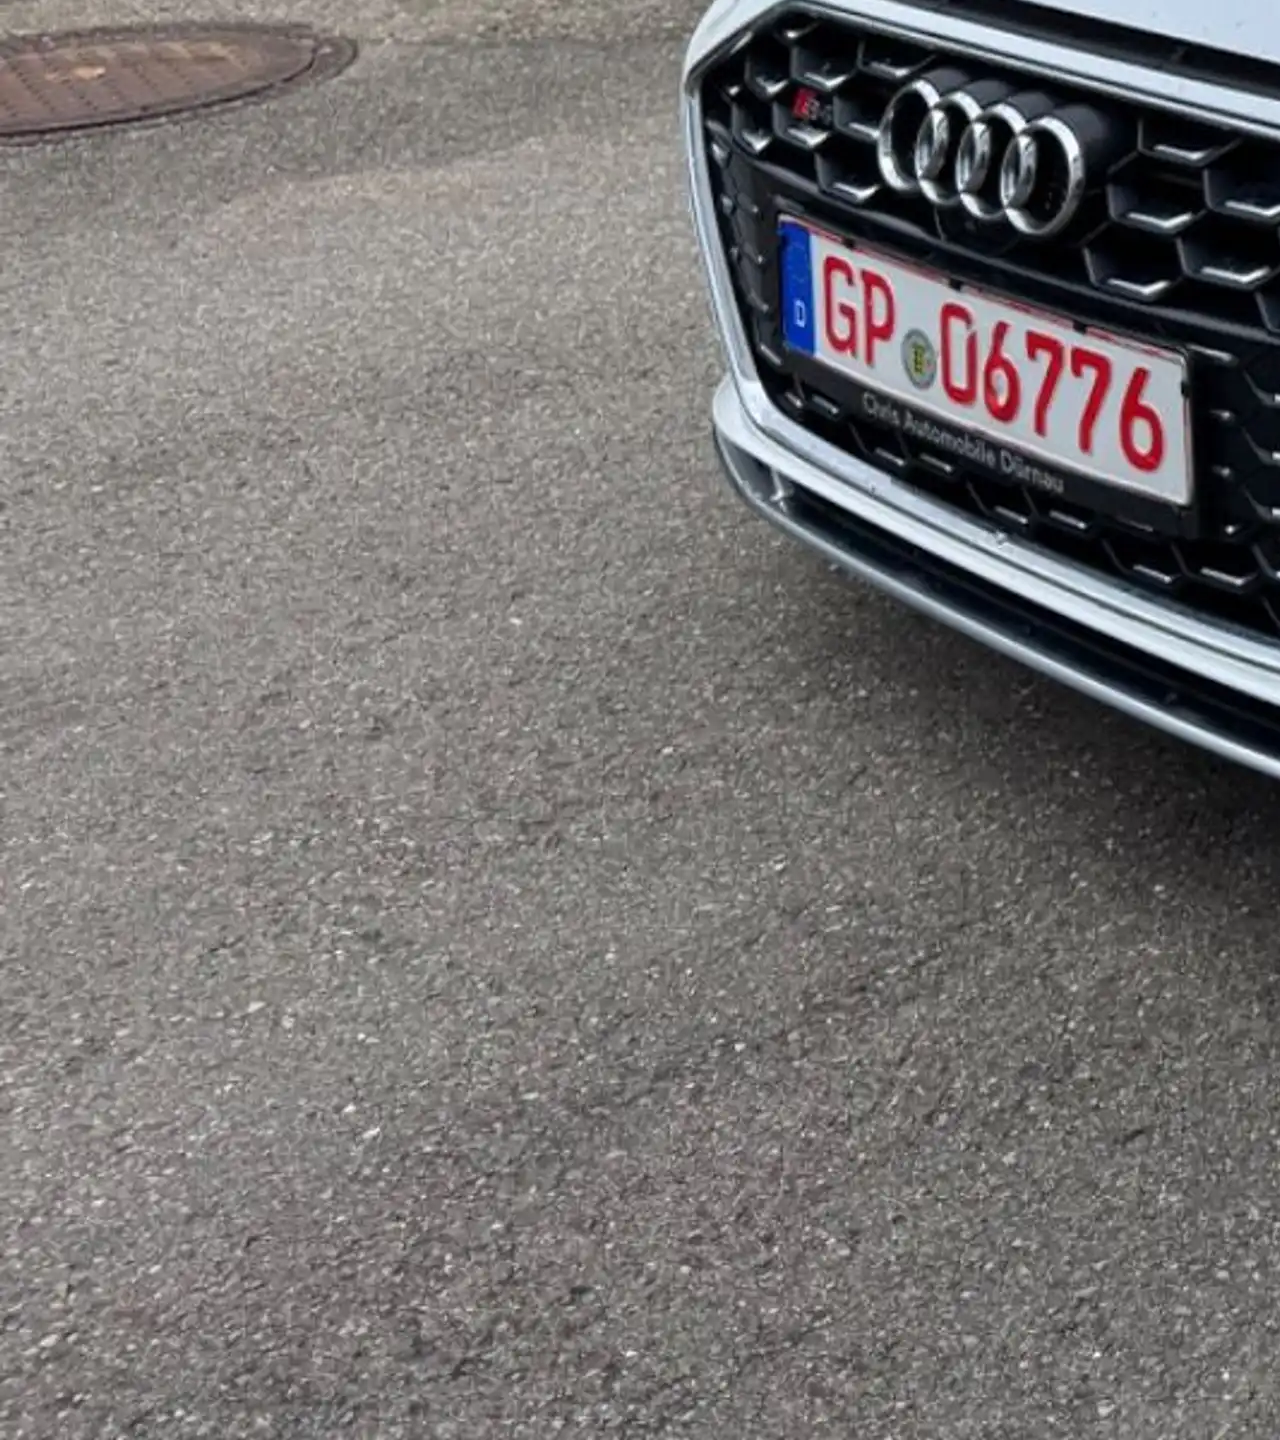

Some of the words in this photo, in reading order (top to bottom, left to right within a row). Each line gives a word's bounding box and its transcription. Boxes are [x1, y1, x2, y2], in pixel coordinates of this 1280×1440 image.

[793, 300, 806, 328] D
[822, 254, 896, 366] GP
[938, 301, 1166, 473] 06776
[902, 410, 997, 469] Automobile
